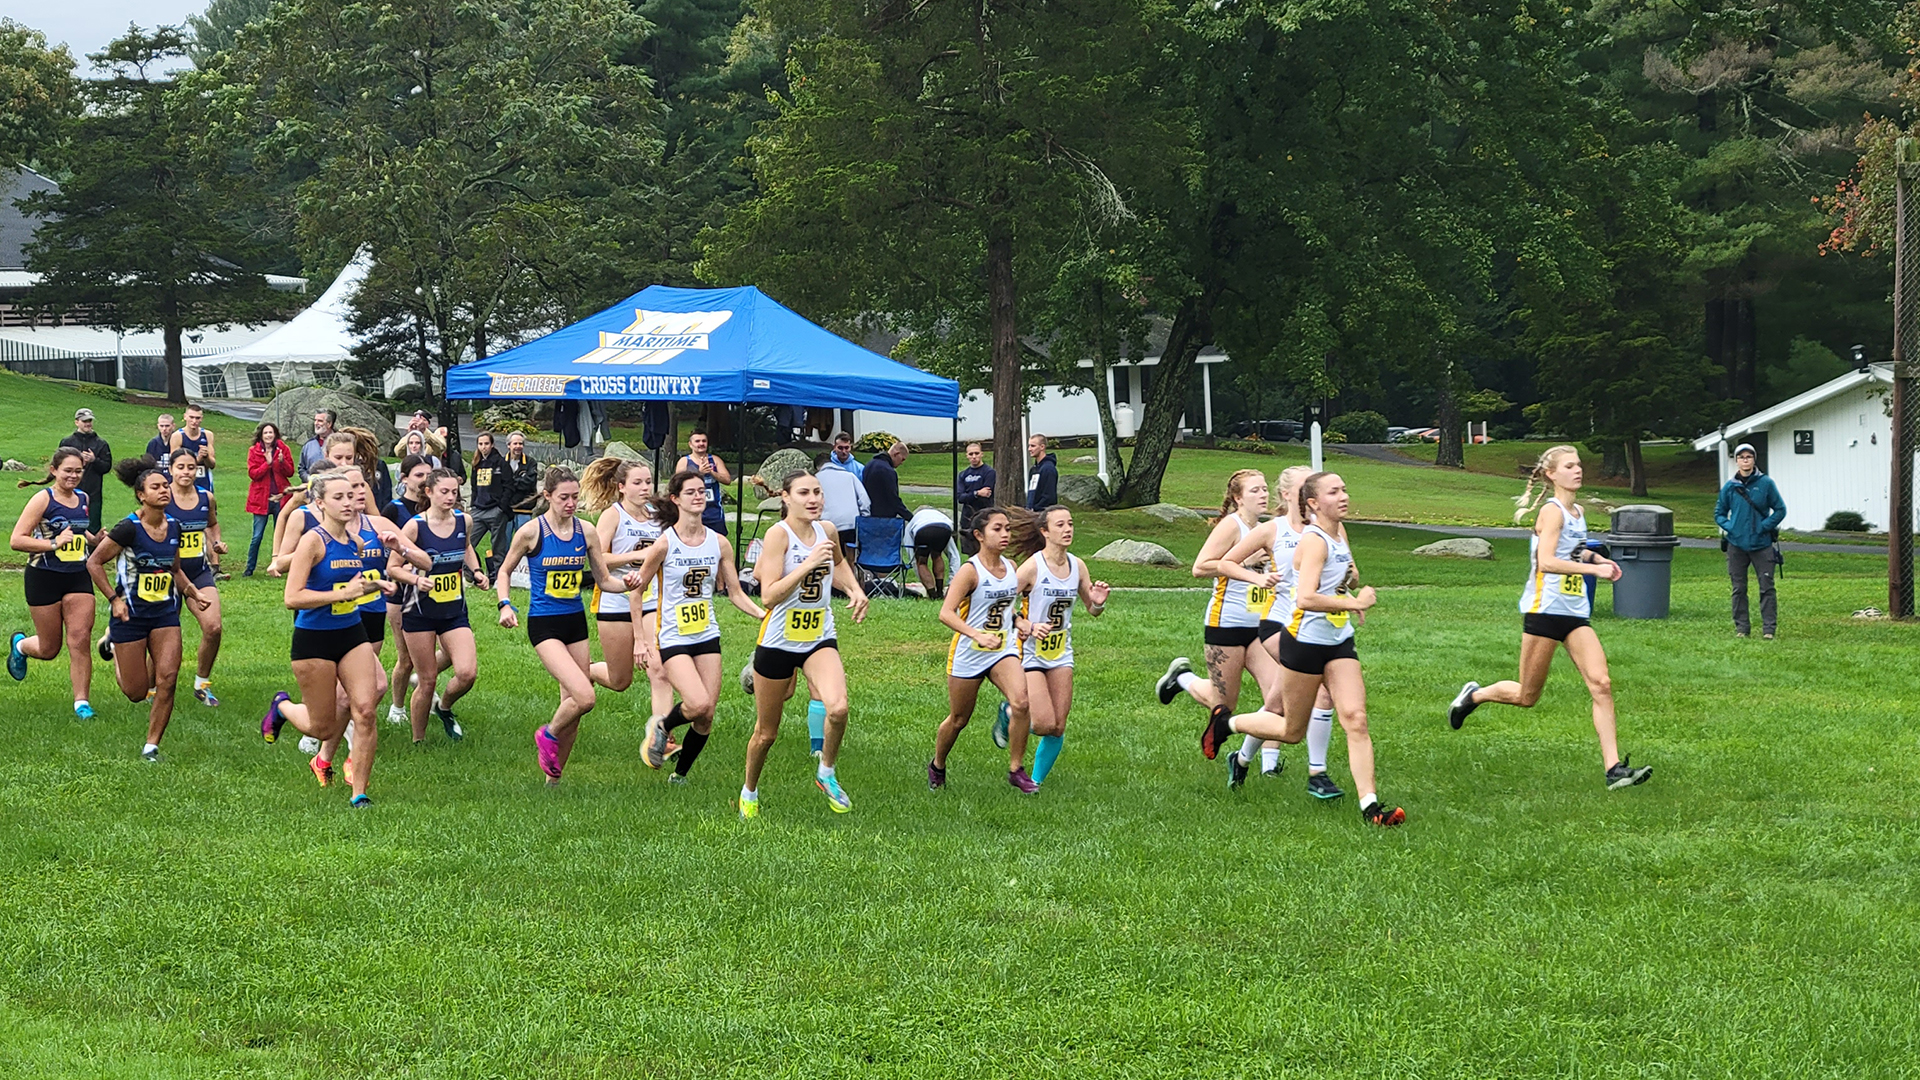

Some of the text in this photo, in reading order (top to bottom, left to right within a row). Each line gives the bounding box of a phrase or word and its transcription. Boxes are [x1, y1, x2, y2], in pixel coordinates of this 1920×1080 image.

[613, 335, 701, 348] MARITIME
[580, 375, 626, 394] CROSS
[629, 376, 702, 395] COUNTRY
[180, 534, 199, 548] 615
[145, 576, 168, 592] 606
[434, 575, 457, 592] 608
[552, 572, 578, 590] 624
[681, 603, 706, 623] 596
[791, 611, 821, 630] 595
[1041, 633, 1063, 652] 597
